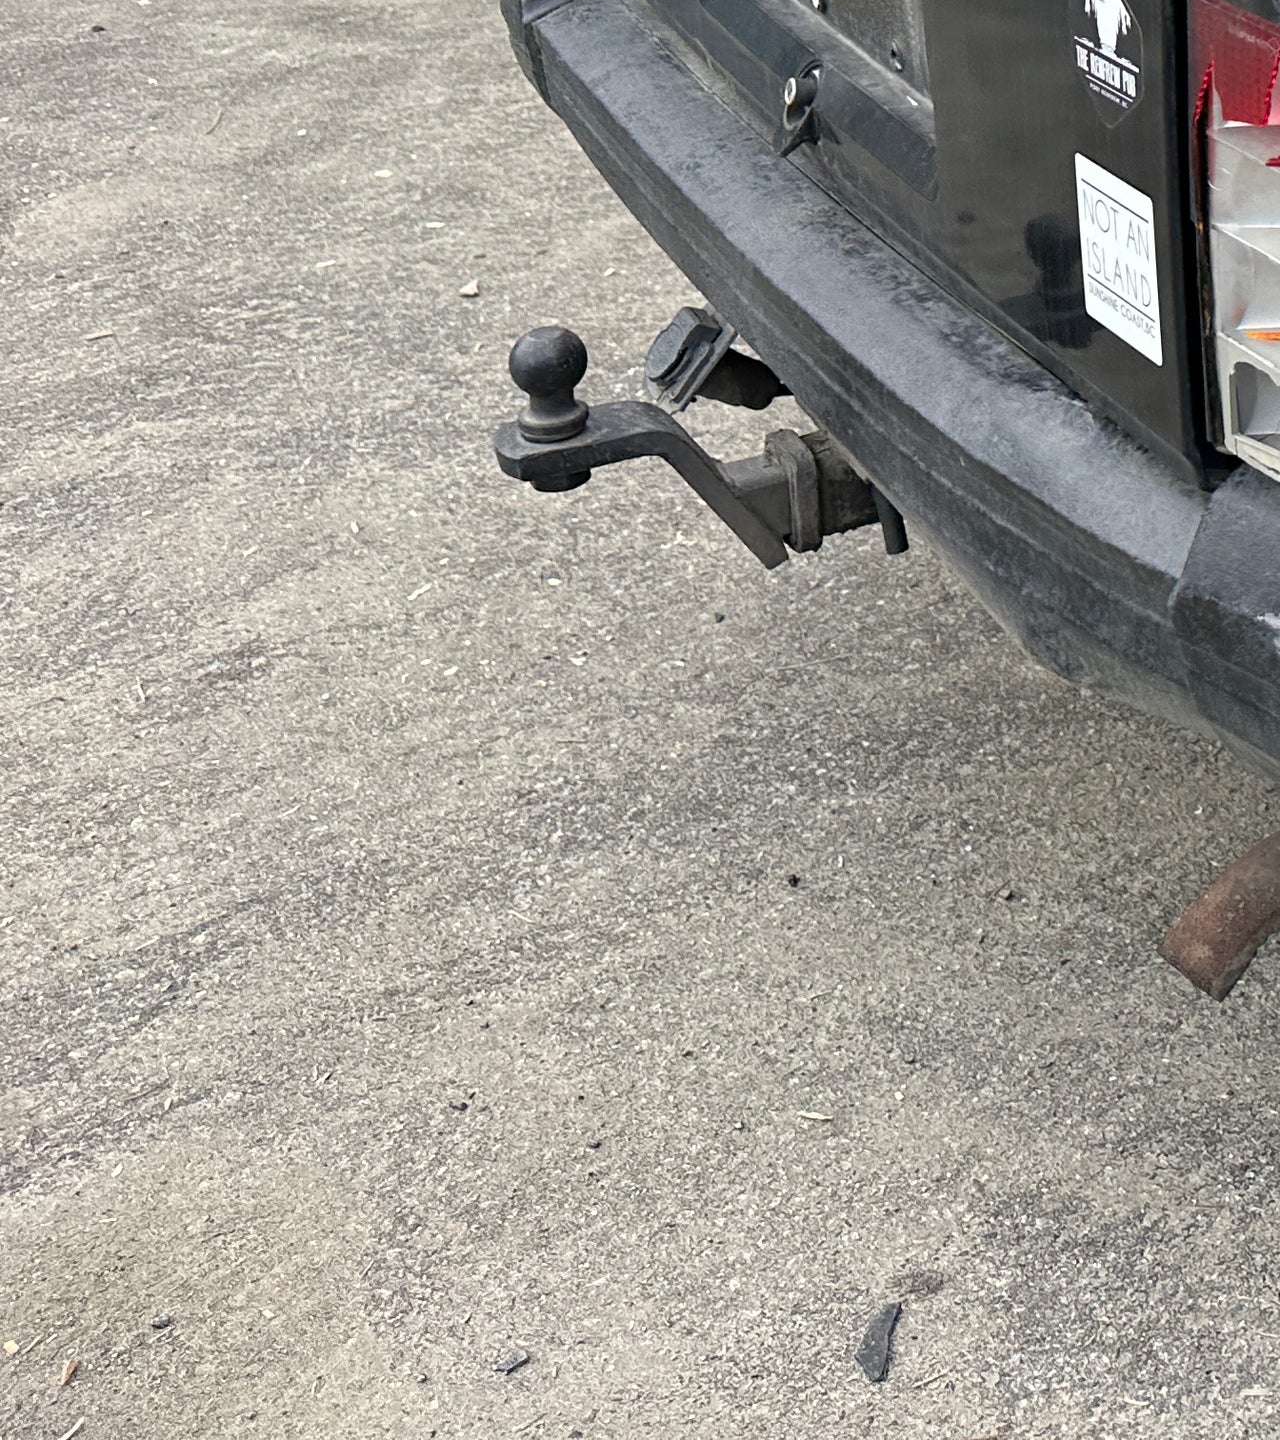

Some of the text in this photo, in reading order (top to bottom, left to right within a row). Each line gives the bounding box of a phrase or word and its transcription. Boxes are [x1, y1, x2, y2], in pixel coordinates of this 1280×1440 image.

[1083, 188, 1150, 262] NOT AN
[1086, 236, 1152, 308] ISLAND
